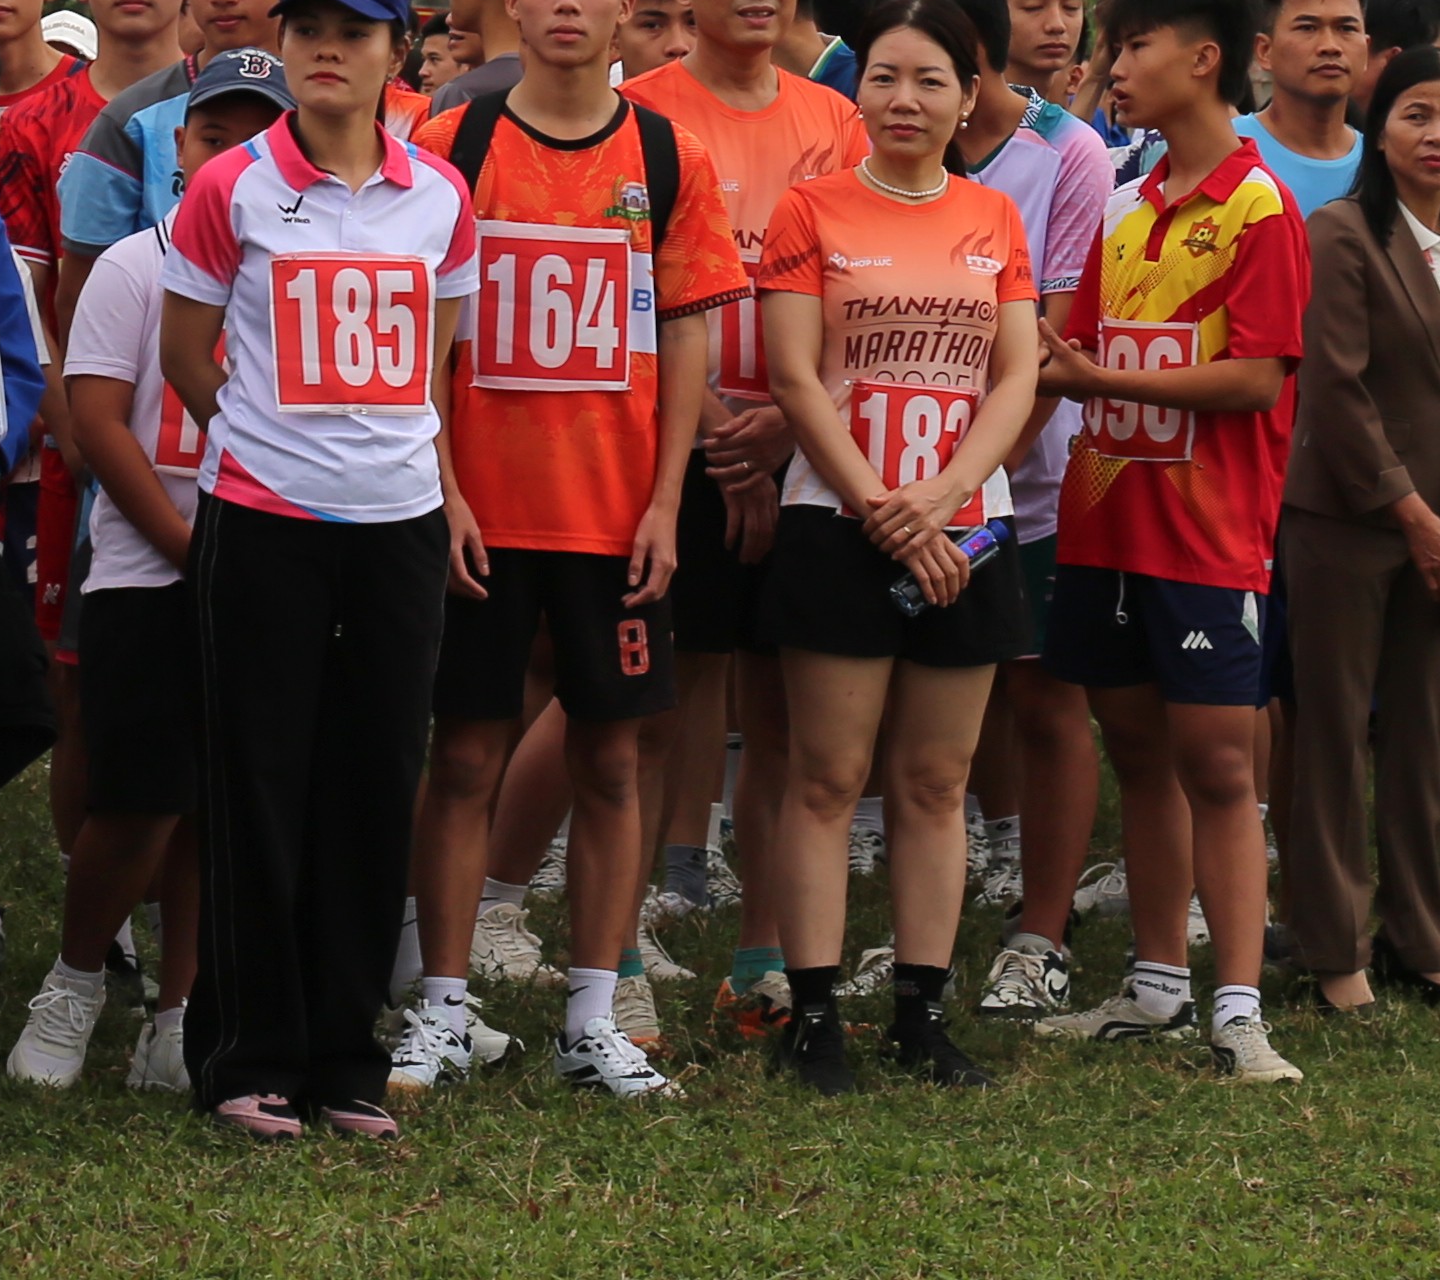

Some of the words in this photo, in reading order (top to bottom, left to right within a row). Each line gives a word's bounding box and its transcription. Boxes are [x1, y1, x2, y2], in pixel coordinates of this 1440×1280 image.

[285, 268, 416, 387] 185
[487, 253, 620, 369] 164
[843, 296, 953, 320] THANH
[844, 329, 993, 371] MARATHON
[617, 619, 649, 676] 8
